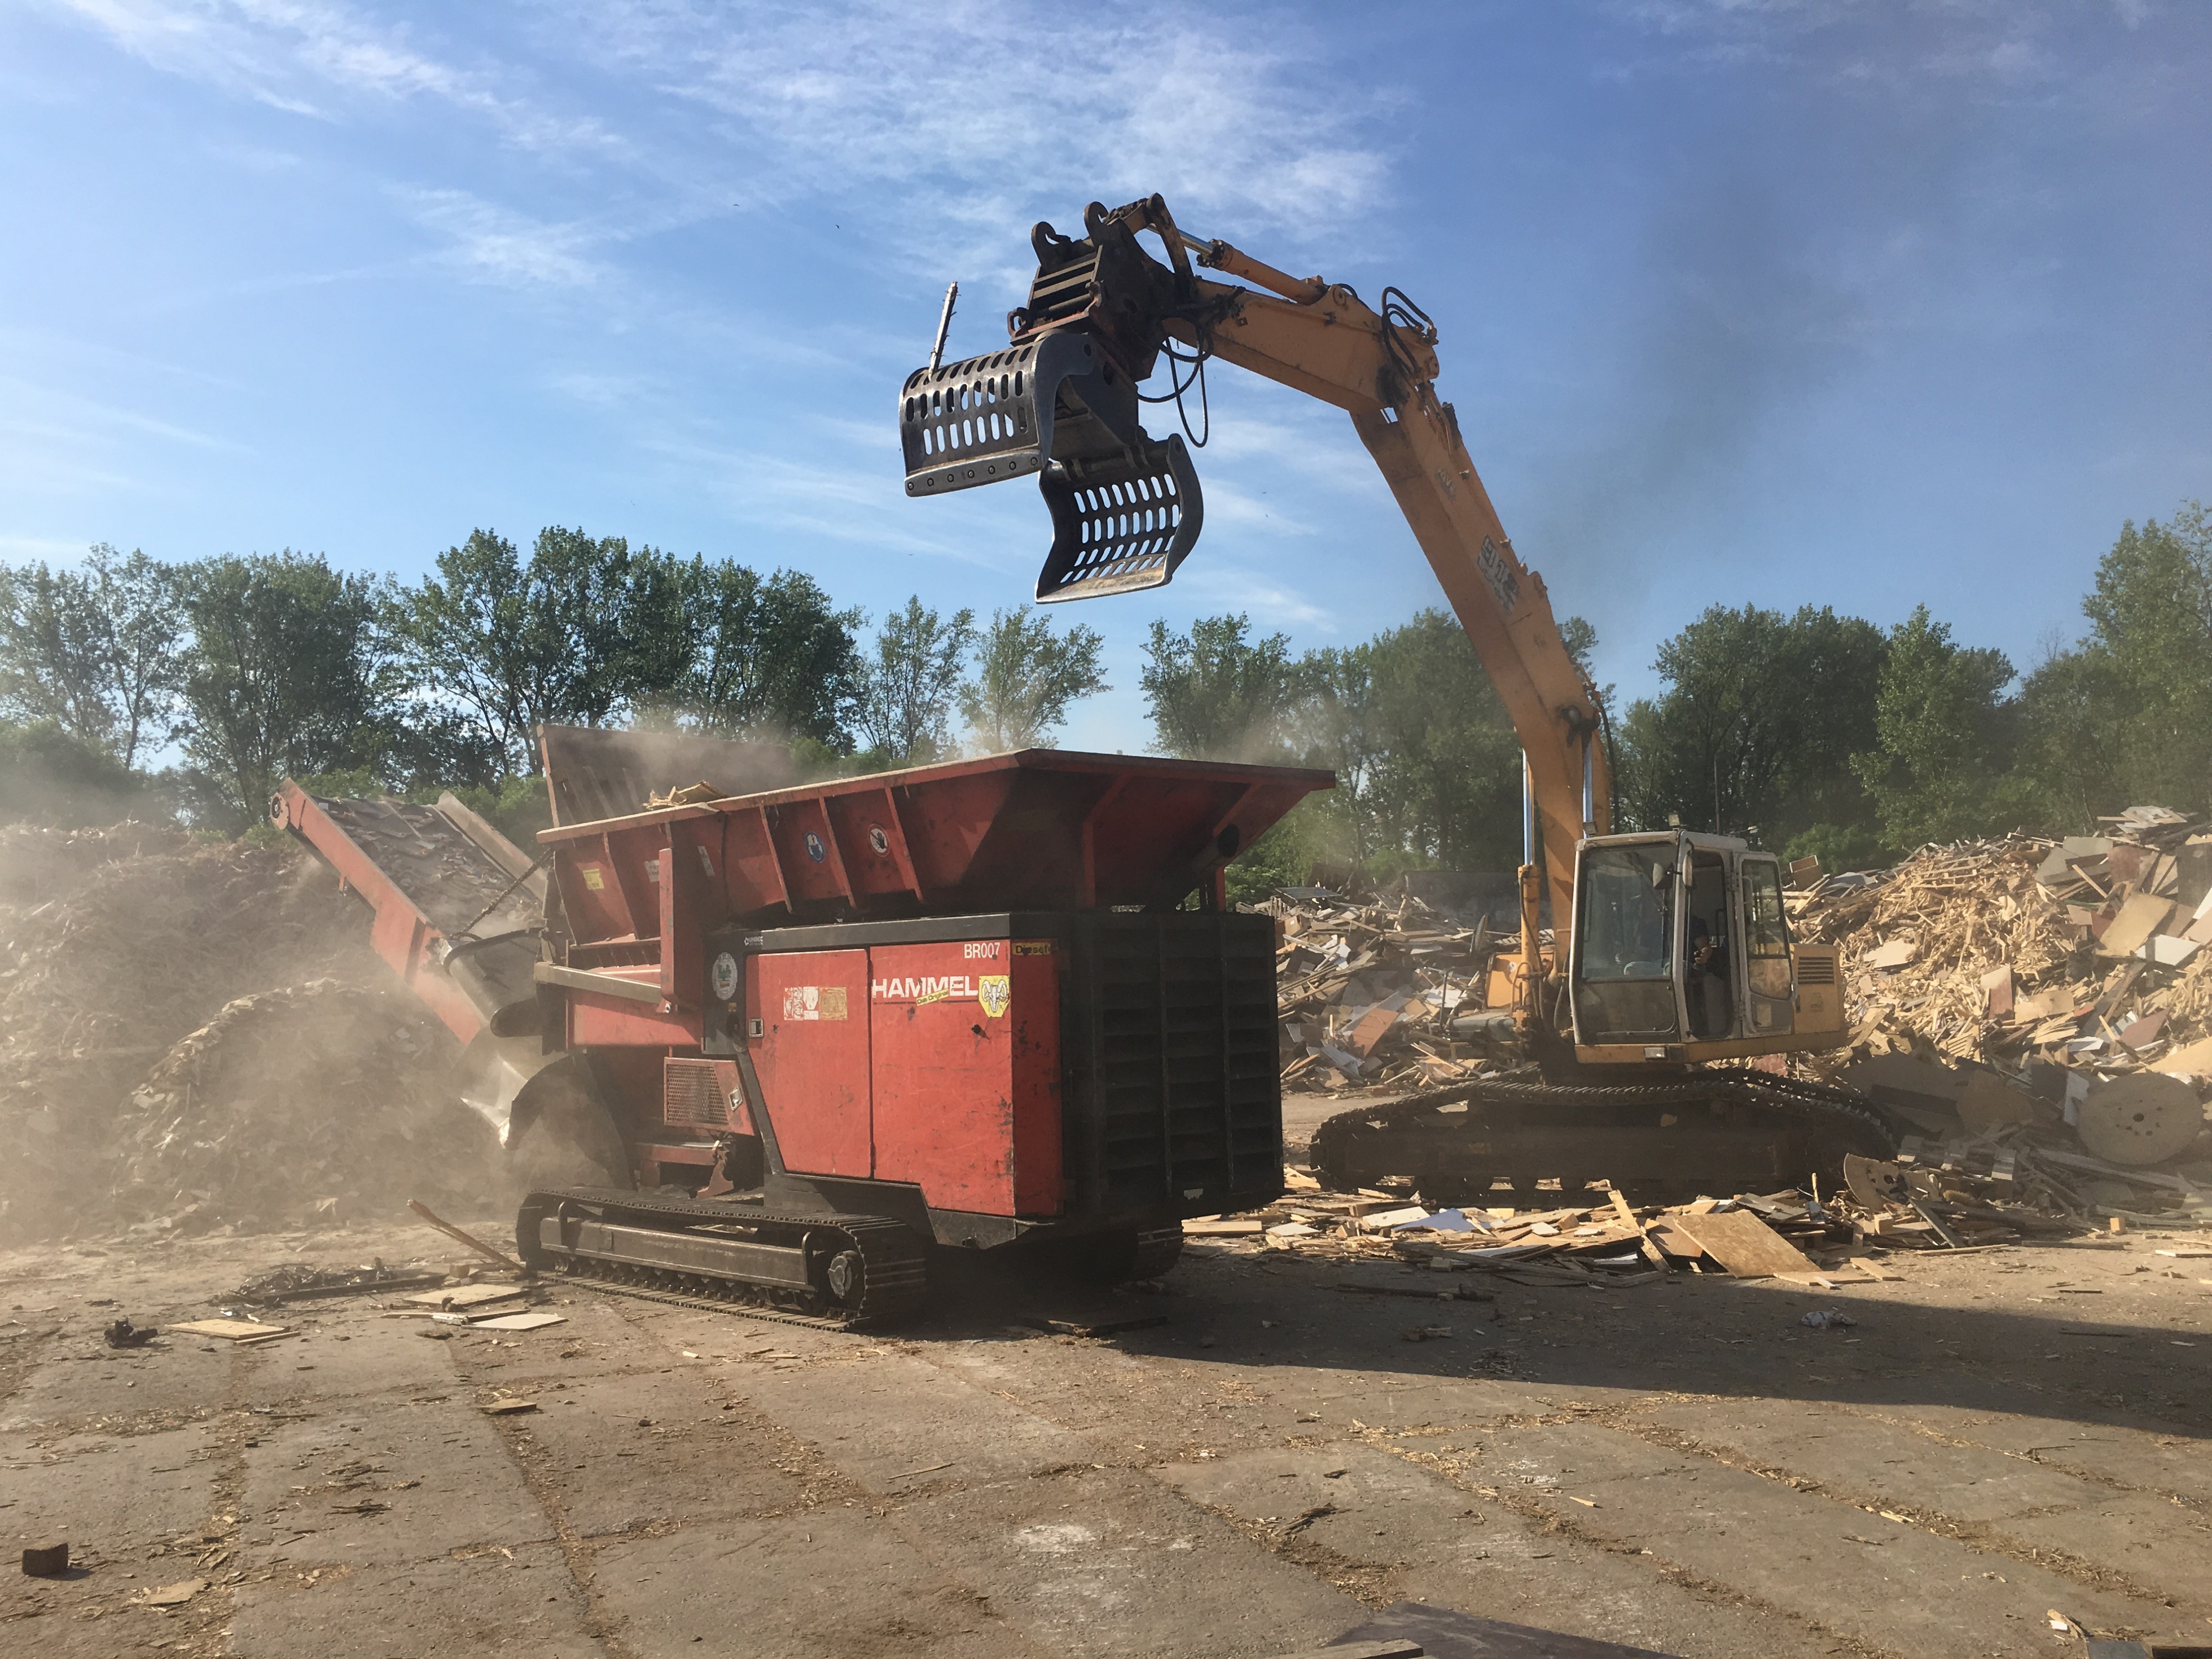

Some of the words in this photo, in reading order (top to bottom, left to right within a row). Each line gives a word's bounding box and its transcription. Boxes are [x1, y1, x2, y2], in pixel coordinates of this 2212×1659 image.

[964, 942, 1000, 958] BR007
[1016, 945, 1047, 954] Desel
[872, 975, 978, 998] HAMMEL
[928, 990, 948, 1001] Original
